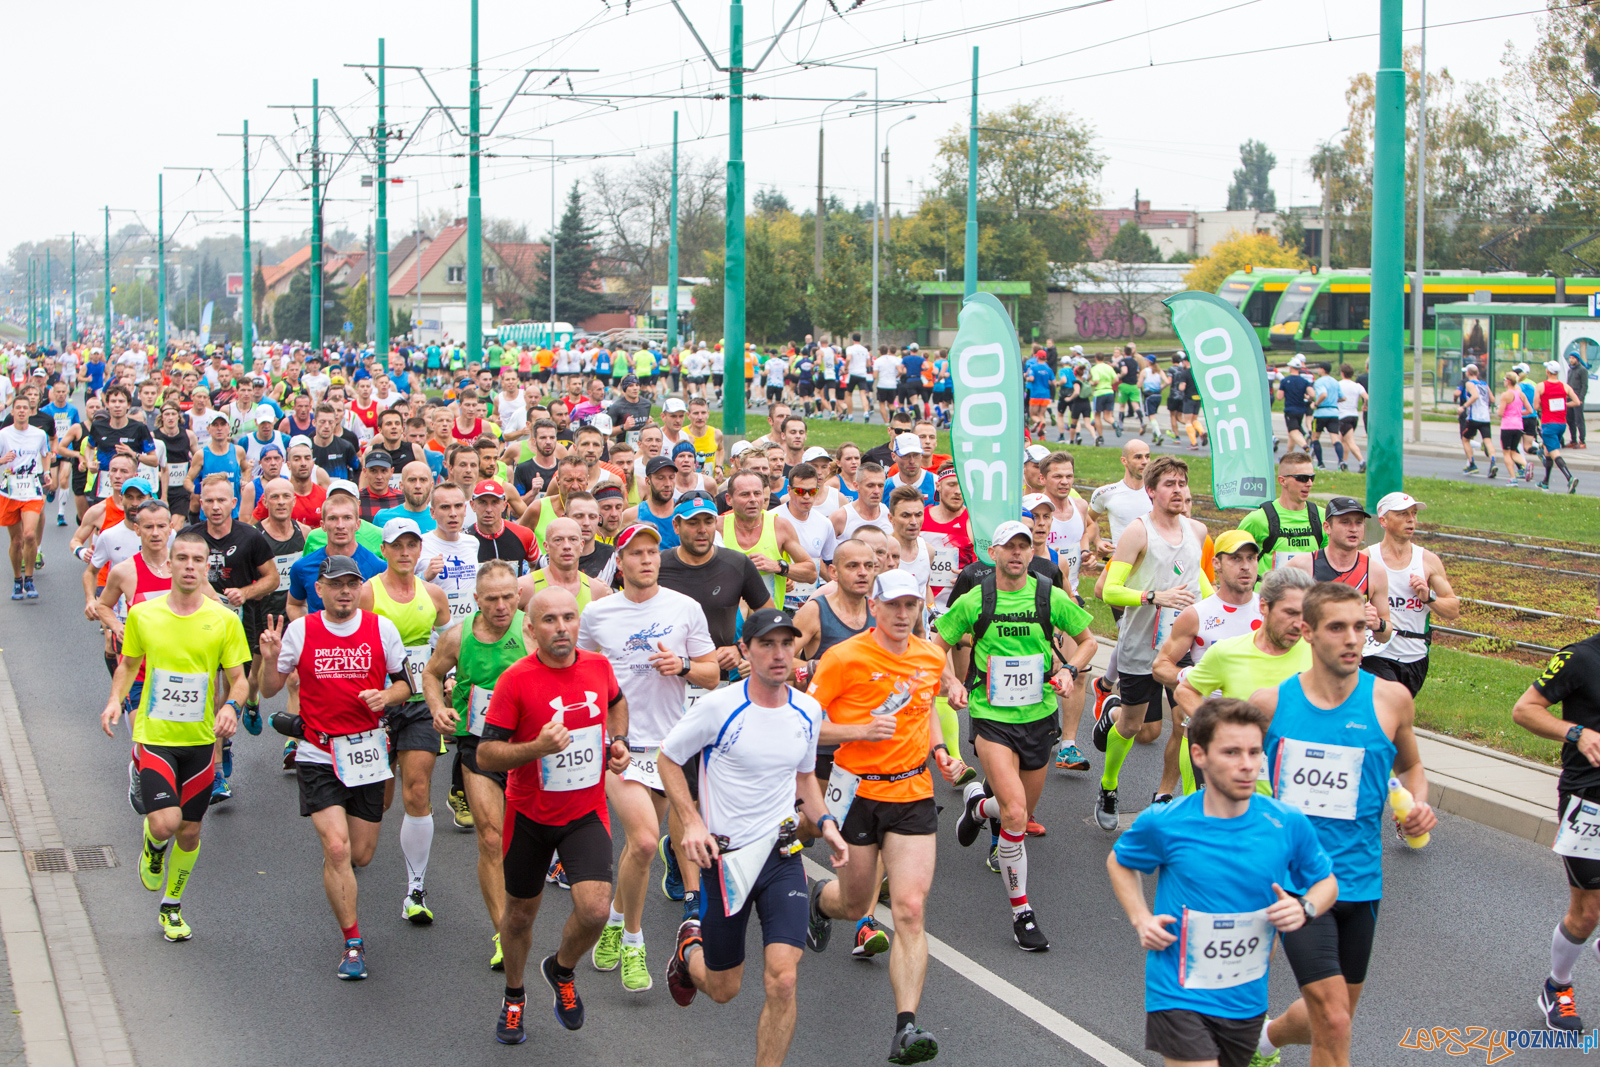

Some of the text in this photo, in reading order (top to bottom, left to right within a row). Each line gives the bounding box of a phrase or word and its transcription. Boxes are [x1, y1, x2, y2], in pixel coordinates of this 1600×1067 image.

[1194, 327, 1251, 454] 3:00
[958, 343, 1008, 501] 3:00
[1286, 537, 1311, 547] Team
[995, 624, 1031, 638] Team
[314, 646, 362, 658] DRUŻYNA
[314, 656, 372, 672] SZPIKU
[1003, 672, 1033, 687] 7181
[162, 688, 199, 703] 2433
[346, 747, 380, 766] 1850
[555, 747, 594, 769] 2150
[629, 756, 658, 774] 548
[1292, 767, 1349, 790] 6045
[1569, 819, 1600, 838] 473
[1203, 936, 1260, 960] 6569
